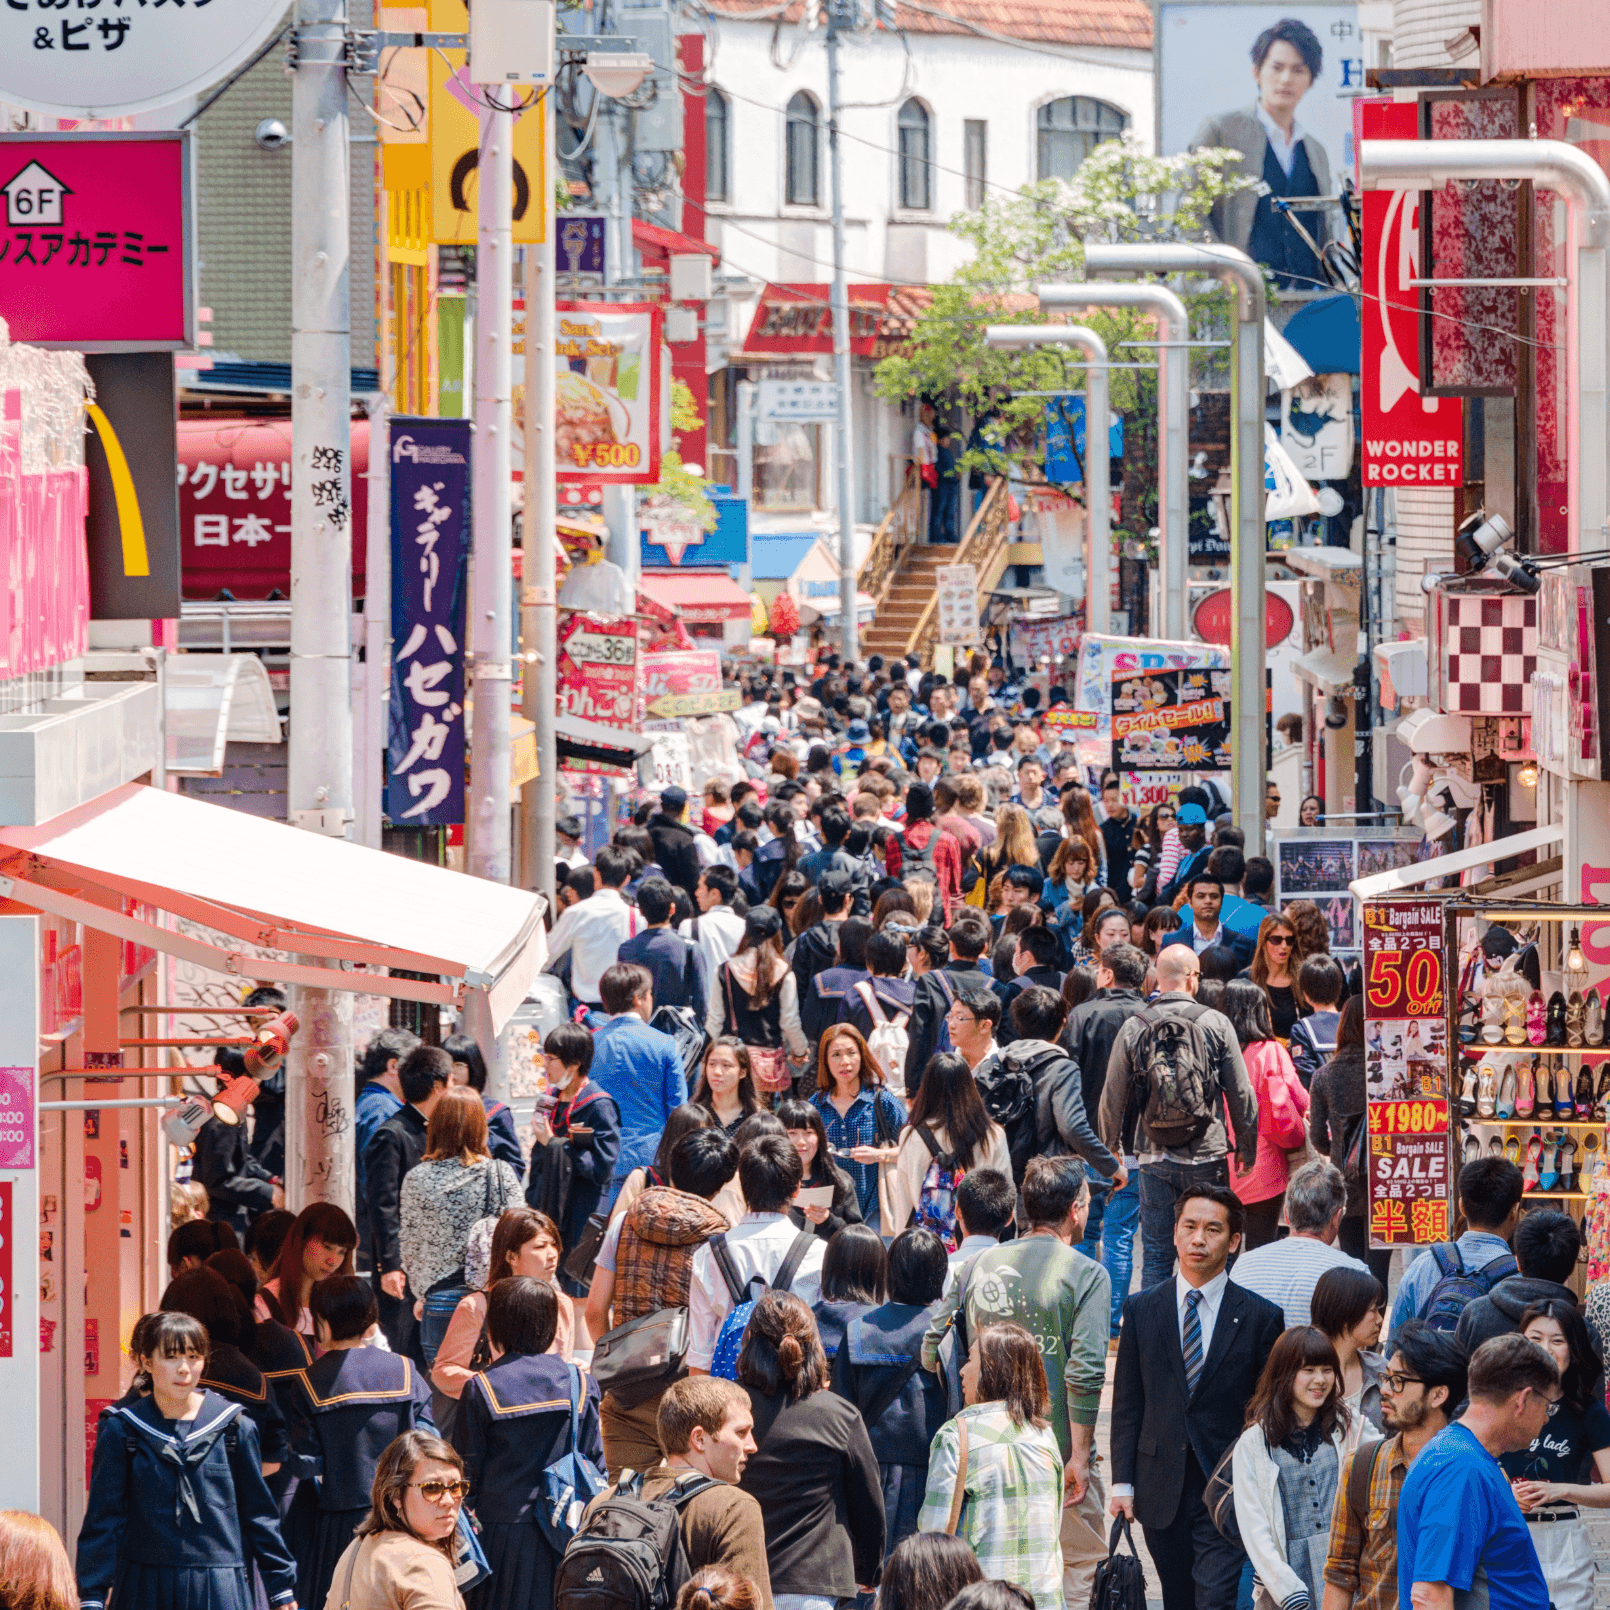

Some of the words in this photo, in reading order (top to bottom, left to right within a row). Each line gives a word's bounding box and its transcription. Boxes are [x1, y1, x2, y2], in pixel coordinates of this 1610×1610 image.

[33, 16, 131, 51] &ピザ
[14, 188, 55, 215] 6F
[0, 231, 169, 267] スアカデミー
[571, 442, 641, 468] ¥500
[1366, 440, 1460, 458] WONDER
[1368, 463, 1460, 481] ROCKET
[392, 624, 463, 819] ハセガワ
[1365, 908, 1386, 925] B1
[1389, 906, 1420, 930] Bargain
[1420, 906, 1441, 924] SALE
[1421, 1076, 1441, 1092] B1
[1372, 1135, 1392, 1150] B1
[1396, 1142, 1424, 1157] Bargain
[1425, 1141, 1444, 1154] SALE
[1376, 1156, 1446, 1179] SALE
[1371, 1198, 1449, 1243] 半額
[1543, 1433, 1571, 1458] lady
